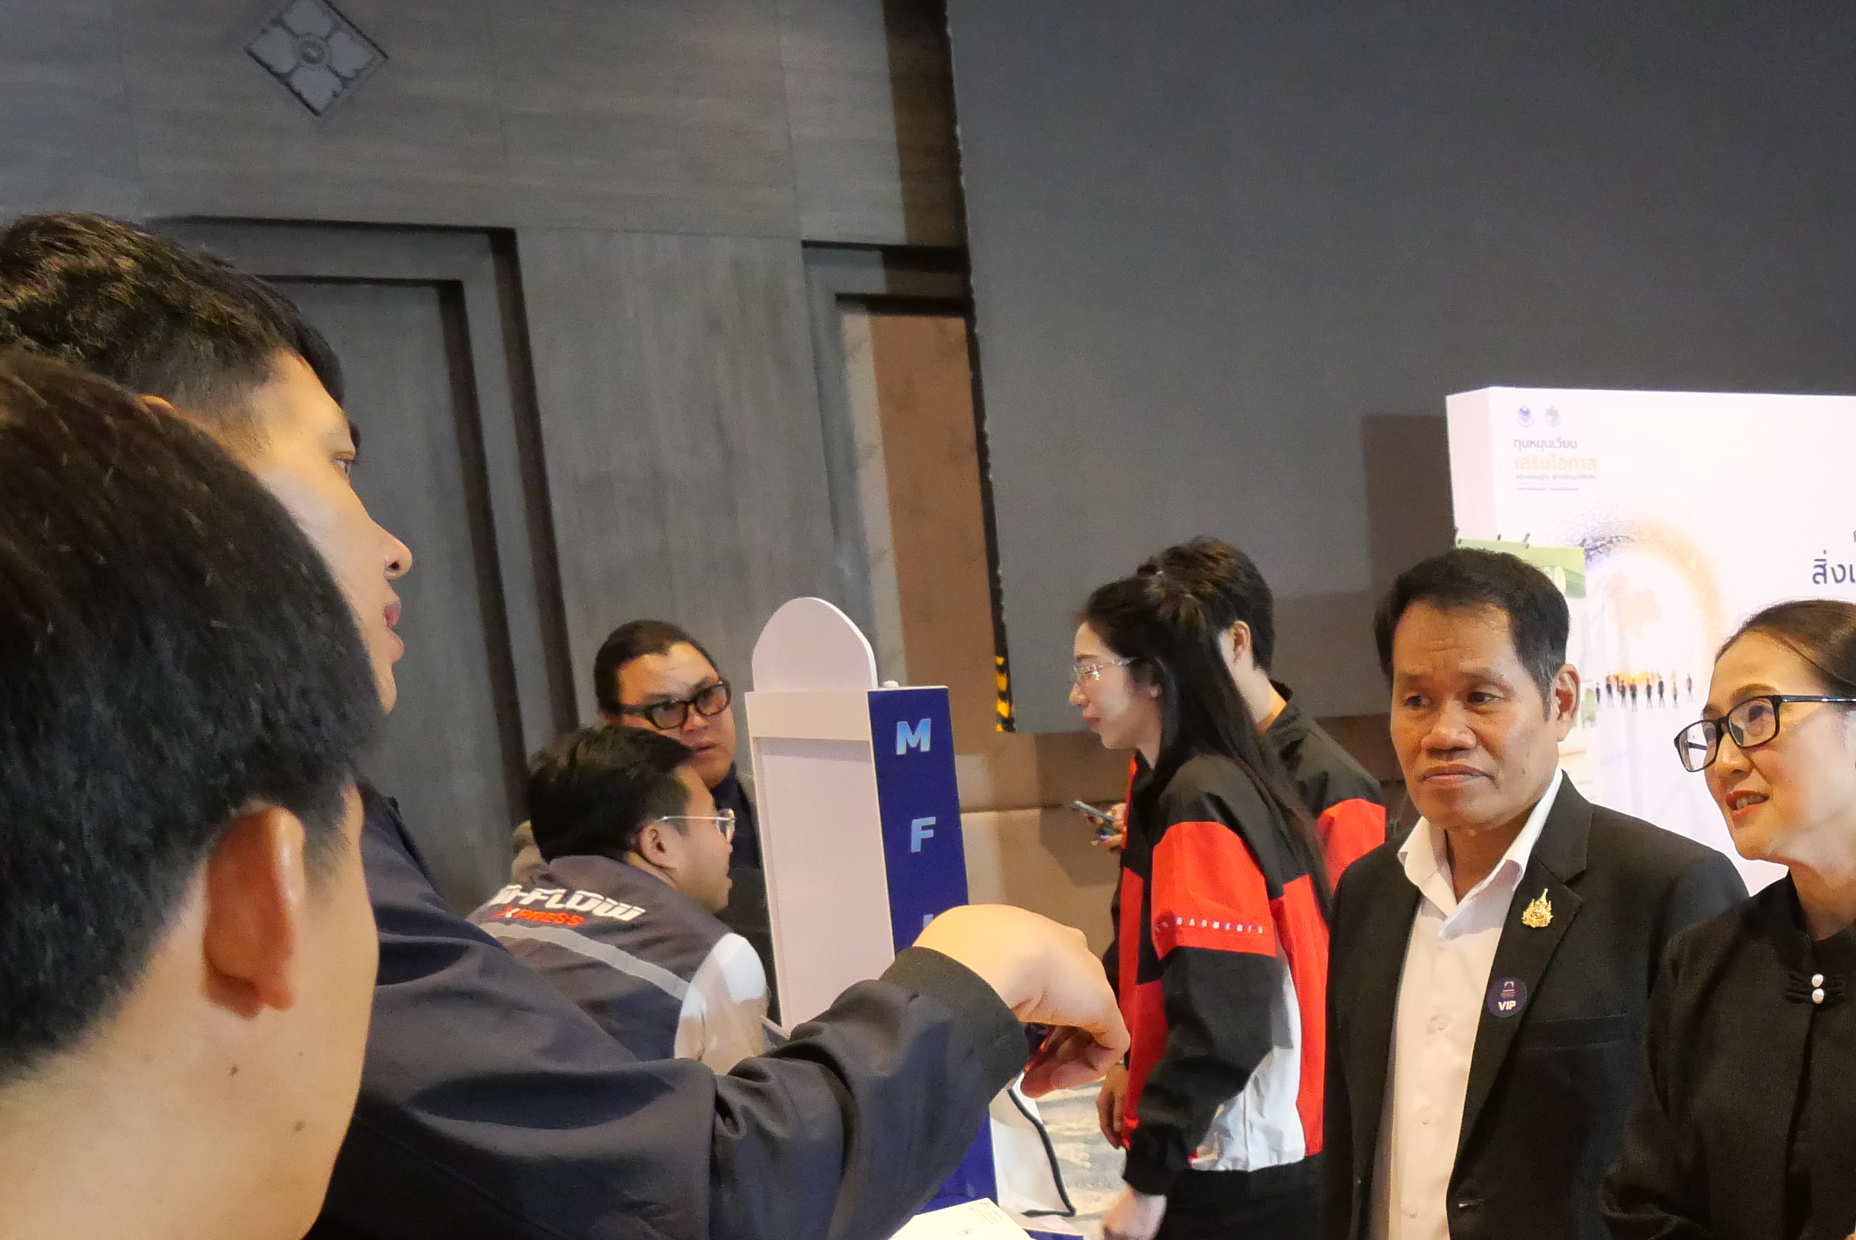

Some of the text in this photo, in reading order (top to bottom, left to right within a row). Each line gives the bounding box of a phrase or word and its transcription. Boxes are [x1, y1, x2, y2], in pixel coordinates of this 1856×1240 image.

[1513, 437, 1578, 452] ทุนหมุนเวียน
[1514, 453, 1597, 471] เสริมโอกาส
[1498, 1000, 1517, 1011] VIP
